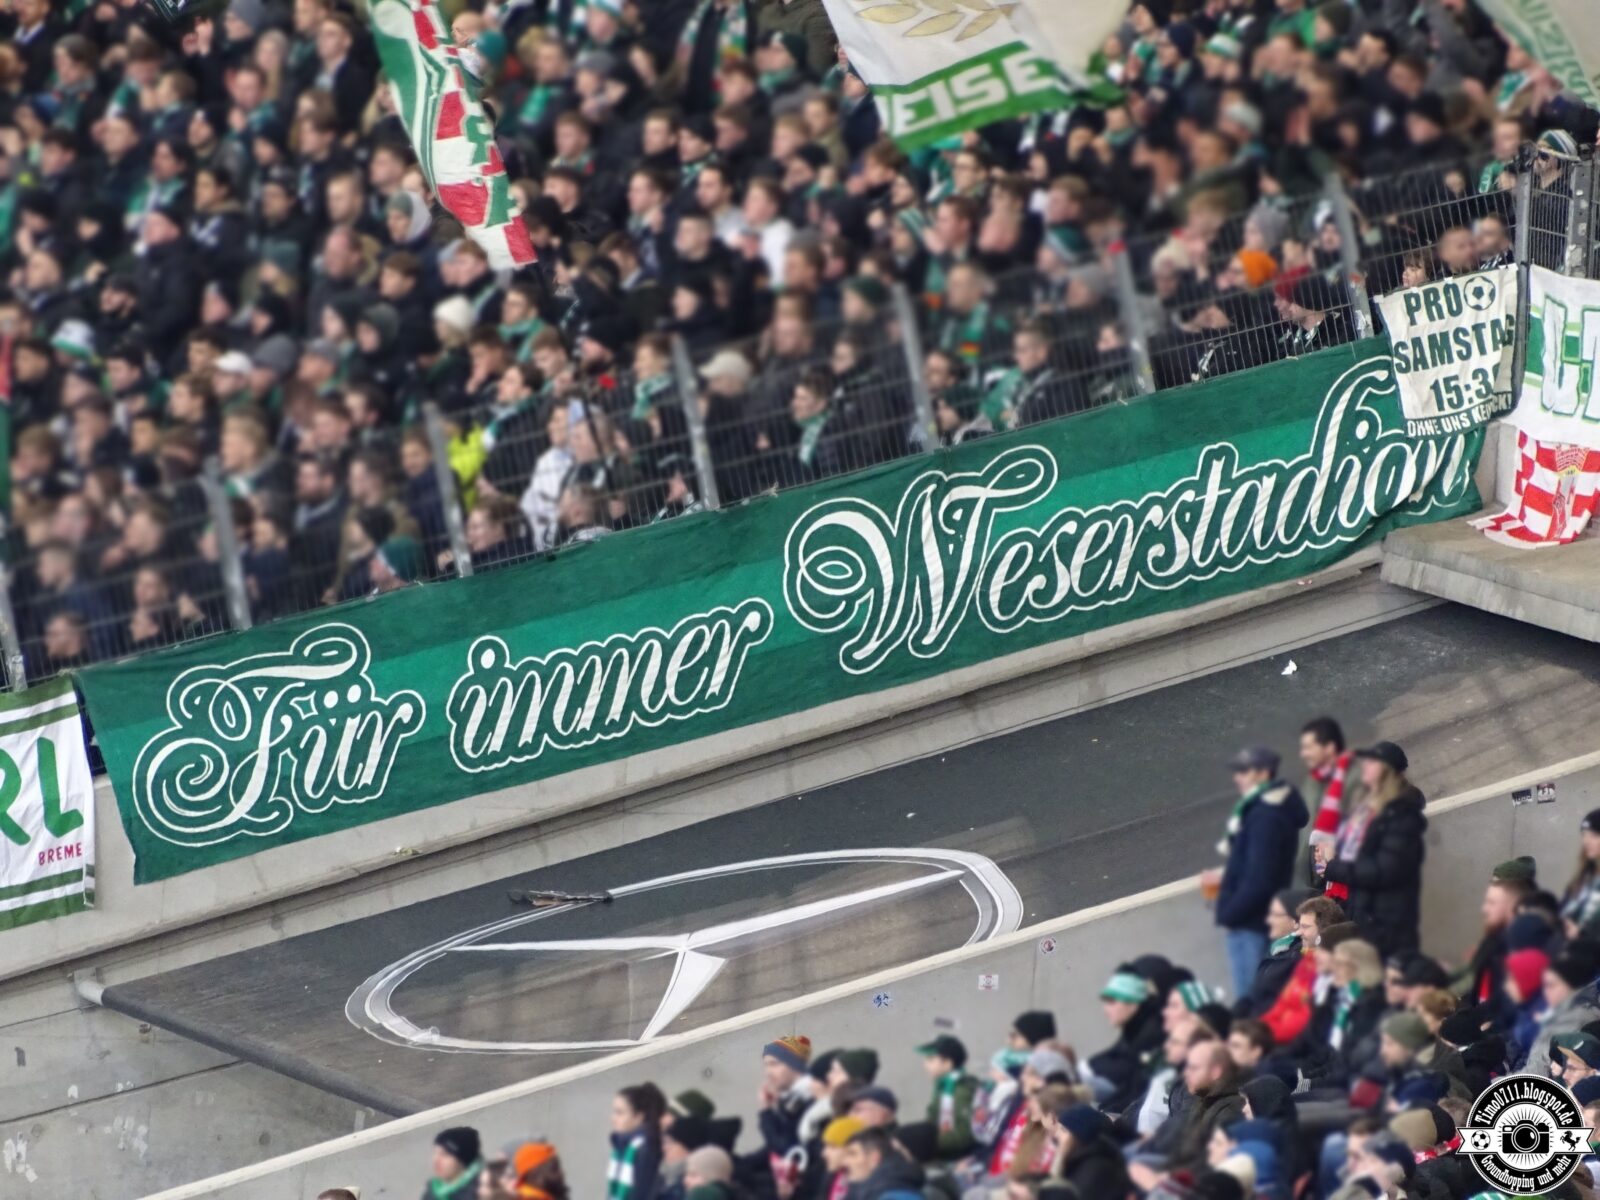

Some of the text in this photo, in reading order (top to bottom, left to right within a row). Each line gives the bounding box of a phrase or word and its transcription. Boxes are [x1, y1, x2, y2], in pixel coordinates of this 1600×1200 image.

[1403, 283, 1464, 326] PRO
[1393, 314, 1515, 374] SAMSTAG
[1407, 419, 1442, 438] OHNE
[1441, 412, 1471, 433] UNS
[142, 366, 1466, 836] Für immer Weserstadion
